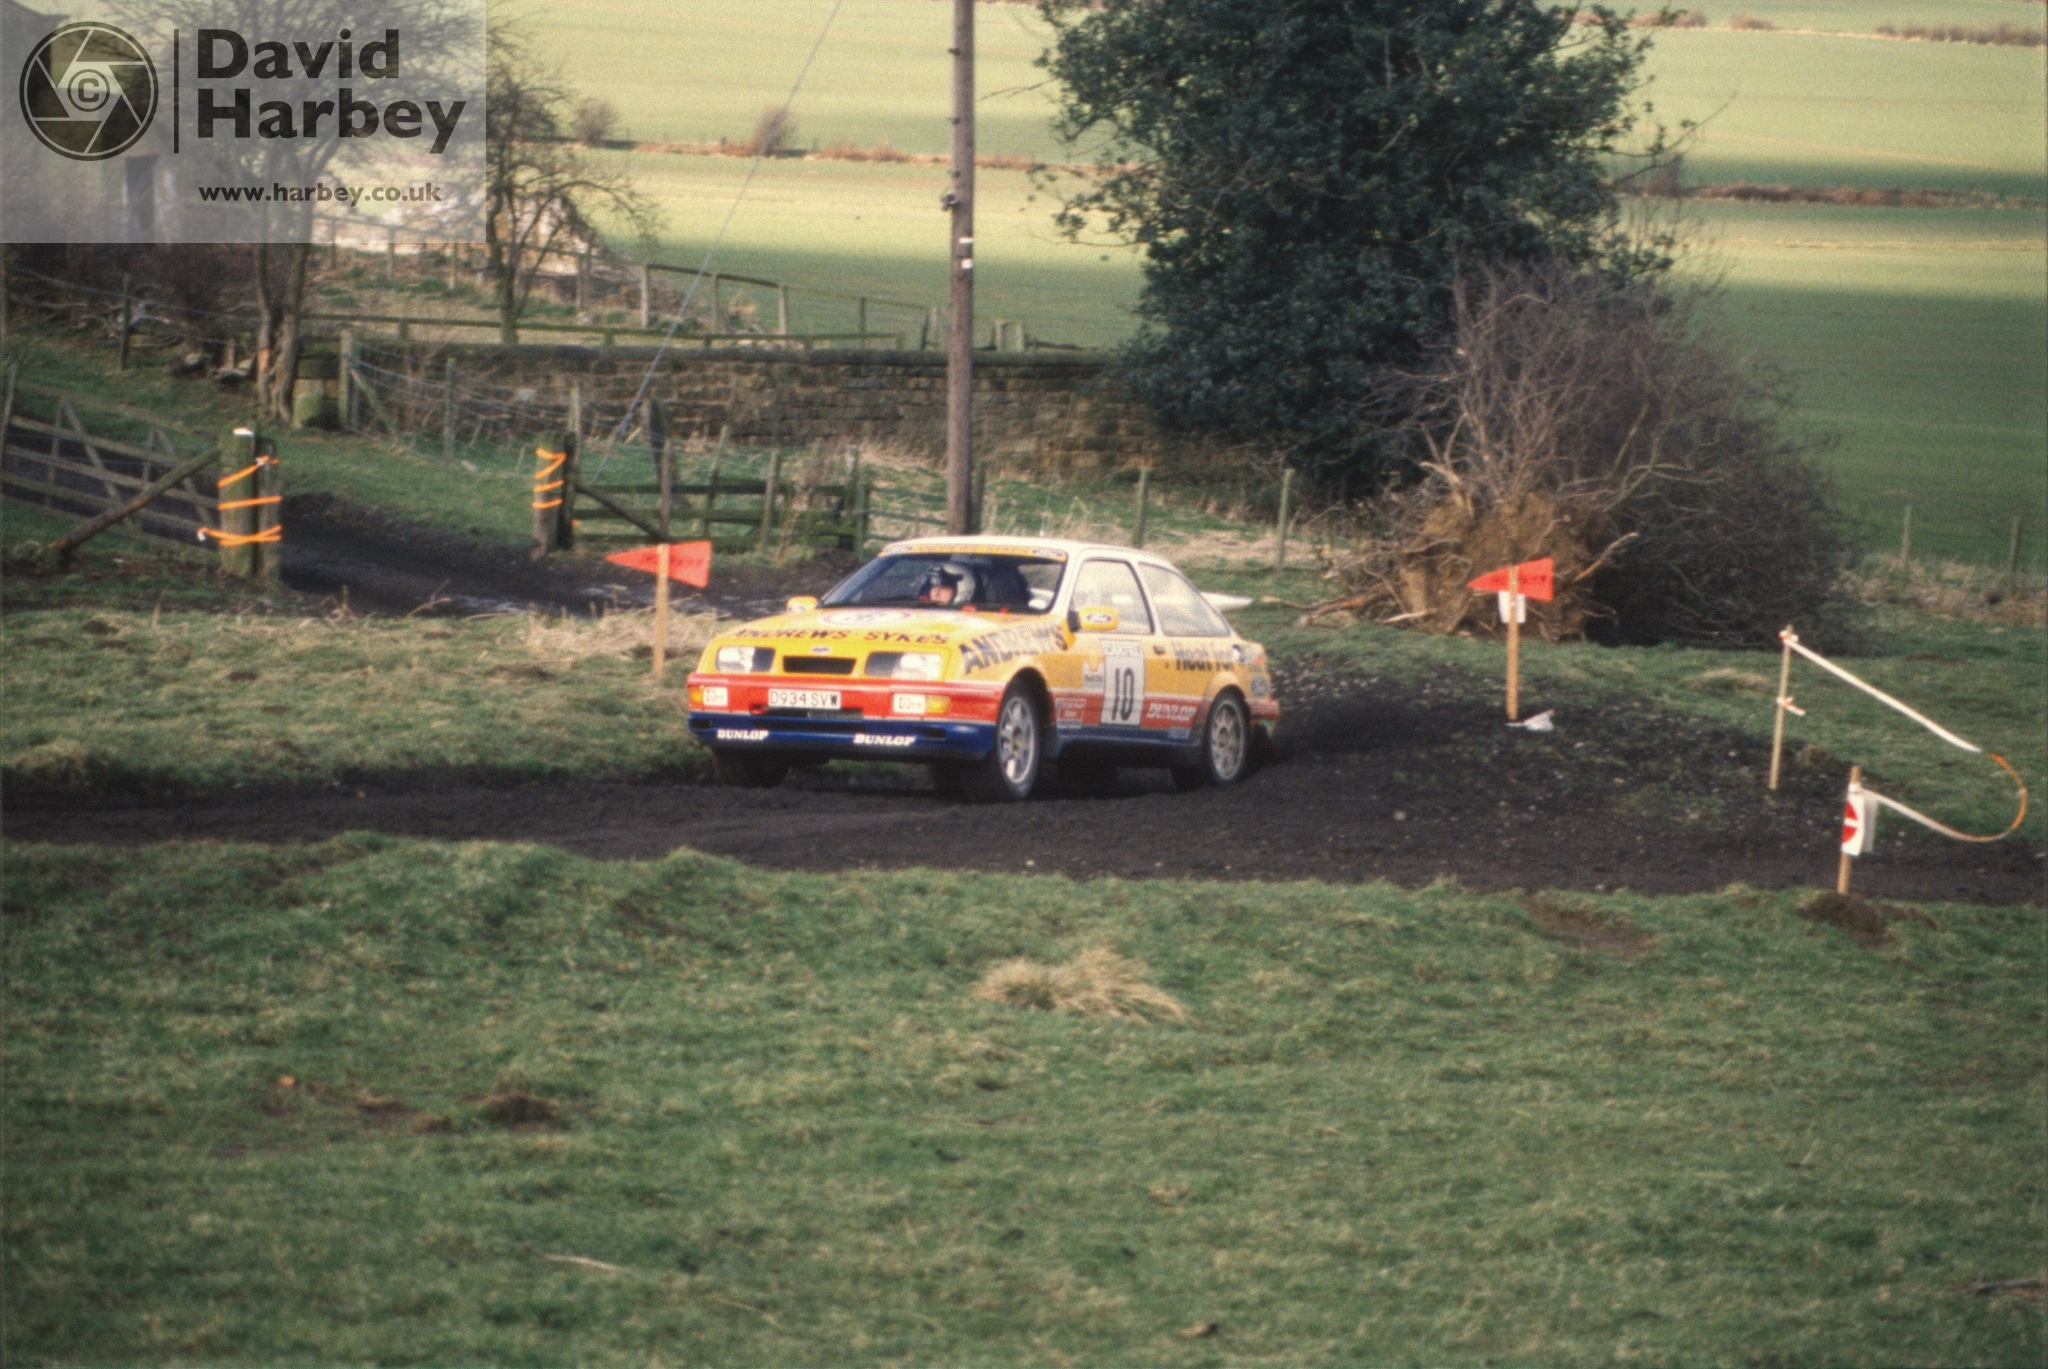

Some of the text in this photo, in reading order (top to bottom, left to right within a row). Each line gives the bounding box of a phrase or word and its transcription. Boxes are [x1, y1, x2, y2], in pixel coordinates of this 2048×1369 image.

[770, 691, 838, 706] D934 SVW
[1111, 667, 1135, 721] 10
[717, 729, 769, 740] DUNLOP
[853, 733, 916, 746] DUNLOP
